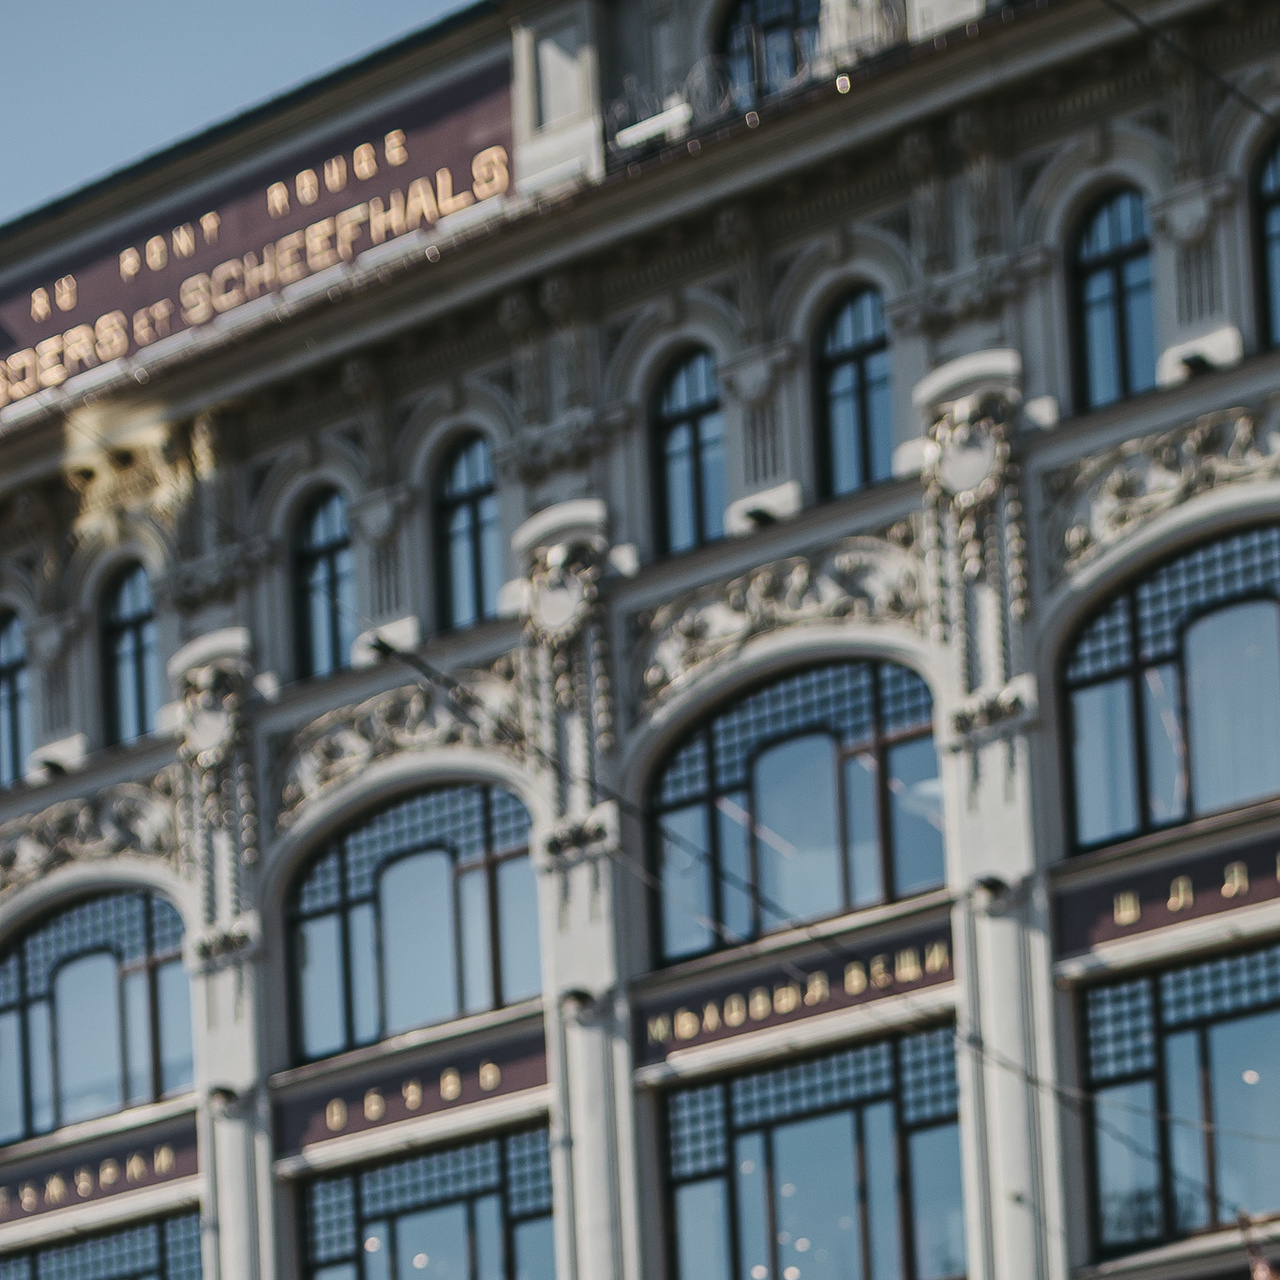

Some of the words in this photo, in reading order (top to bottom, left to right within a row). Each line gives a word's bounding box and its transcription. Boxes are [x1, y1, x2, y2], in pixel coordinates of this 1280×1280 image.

[30, 273, 77, 324] AU
[119, 211, 222, 285] PONT
[266, 129, 409, 219] ROUGE
[179, 145, 510, 327] SCHEEFHALS
